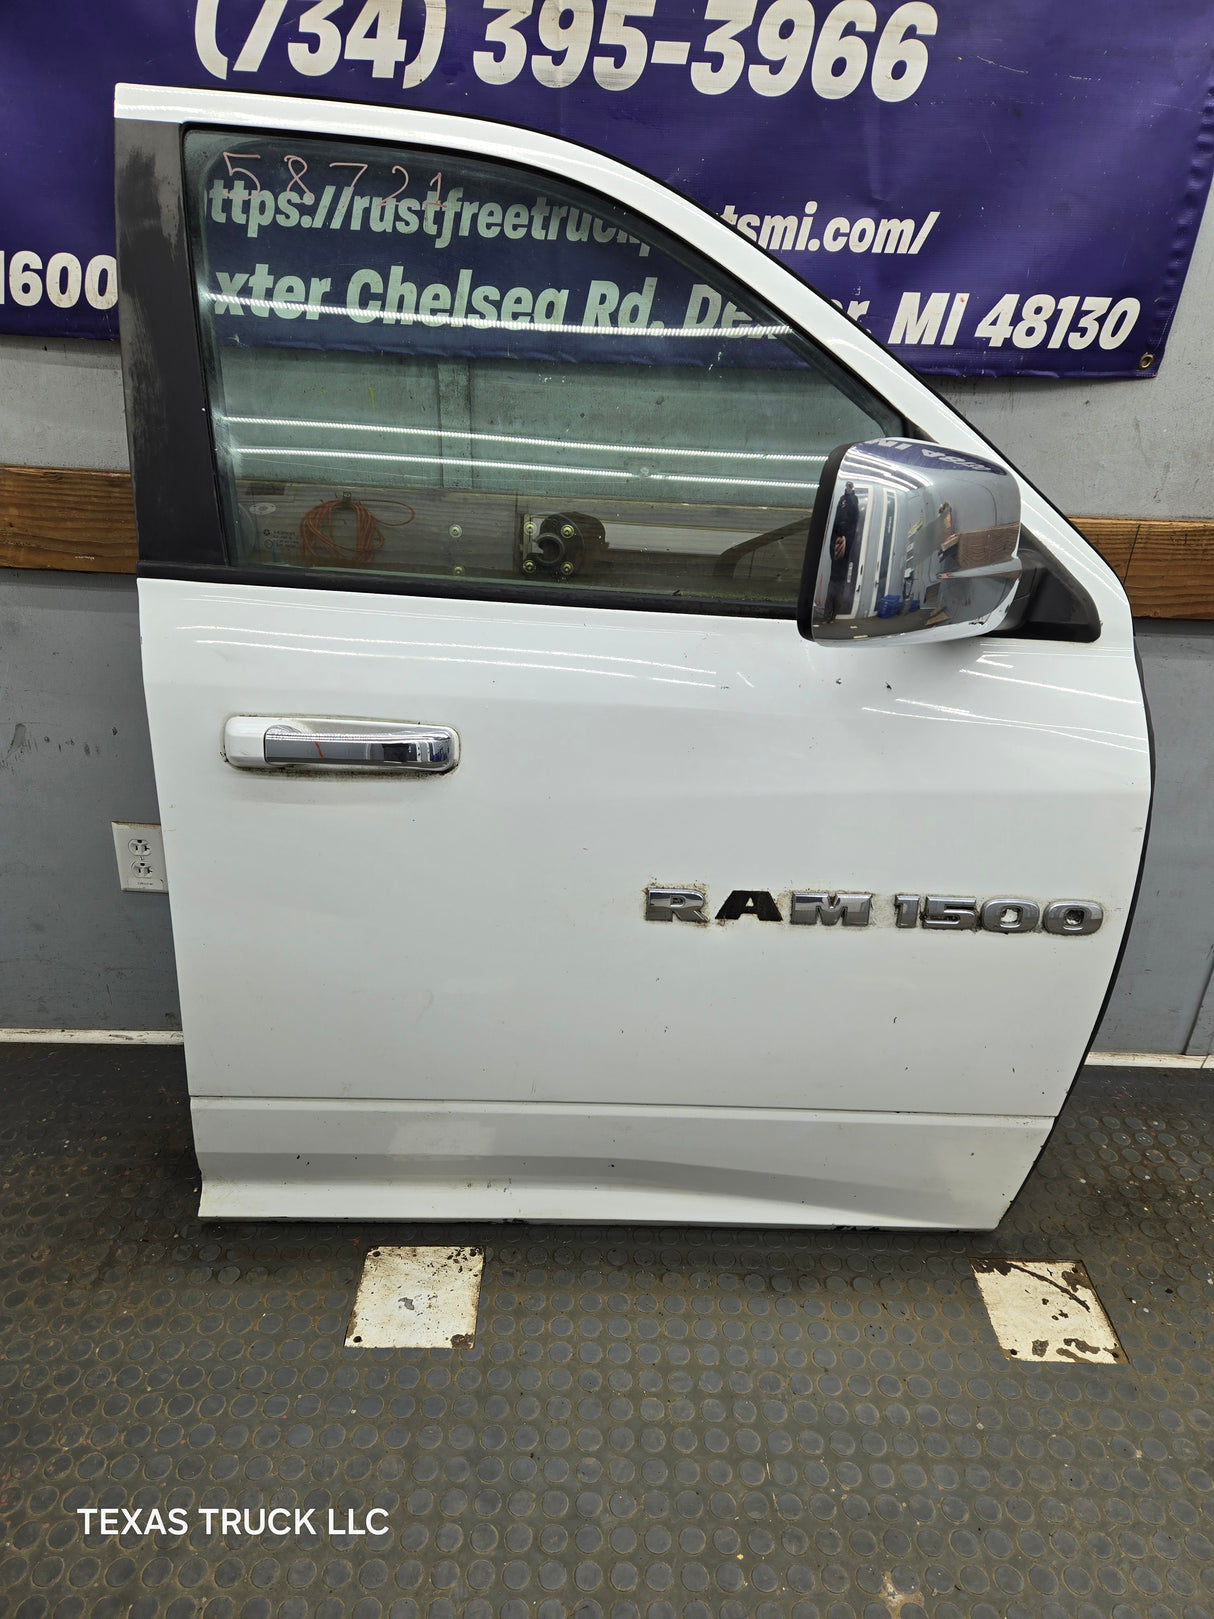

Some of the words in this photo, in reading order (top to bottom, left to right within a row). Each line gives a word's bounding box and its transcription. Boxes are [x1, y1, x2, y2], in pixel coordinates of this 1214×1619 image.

[473, 0, 939, 102] 395-3966
[0, 250, 119, 310] 600
[214, 263, 331, 321] xter
[346, 265, 569, 333] Chelsea
[582, 277, 665, 335] Rd.
[888, 291, 968, 346] MI
[974, 293, 1141, 351] 48130
[645, 887, 872, 926] RAM
[894, 893, 1104, 936] 1500
